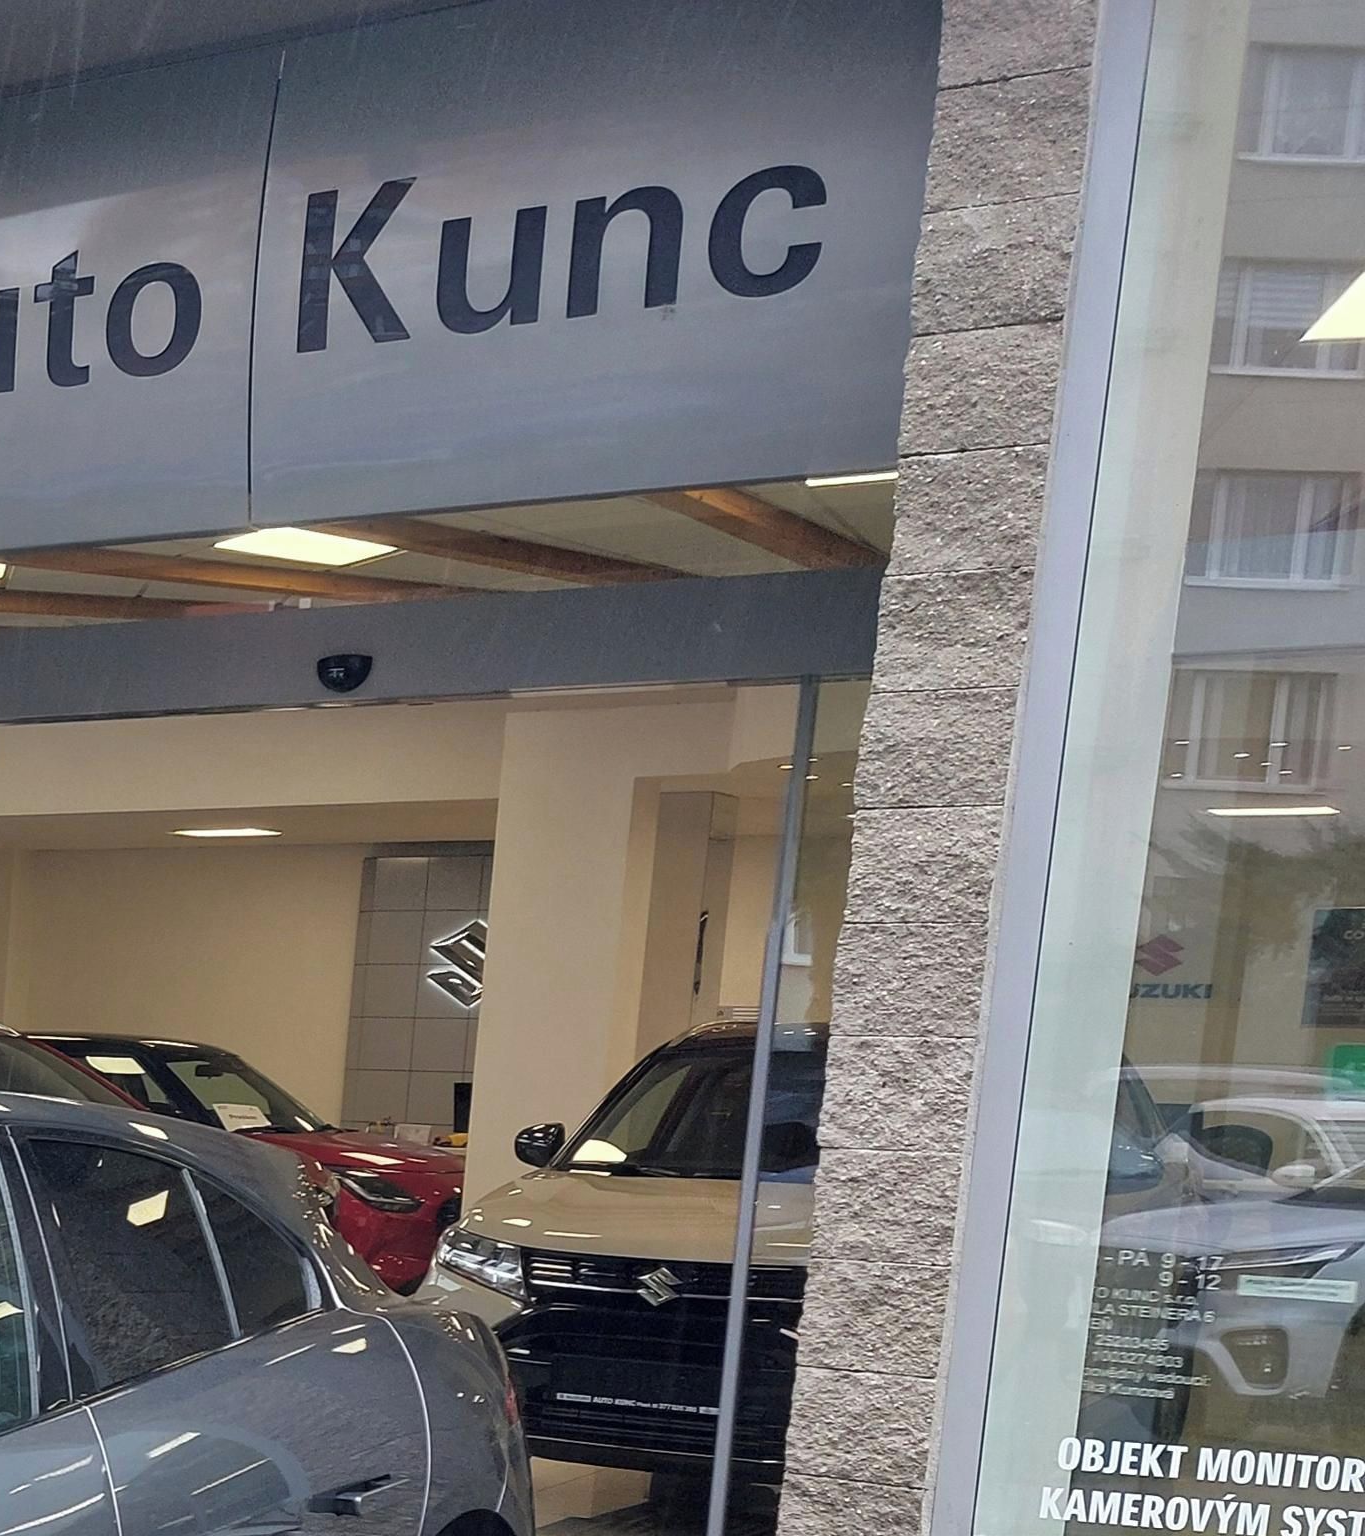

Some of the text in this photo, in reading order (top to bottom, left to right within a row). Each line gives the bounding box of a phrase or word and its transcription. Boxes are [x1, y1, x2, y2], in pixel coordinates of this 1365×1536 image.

[294, 163, 829, 356] Kunc
[1117, 1247, 1151, 1267] PÁ
[1160, 1252, 1177, 1269] 9
[1196, 1255, 1225, 1271] 17
[1158, 1270, 1175, 1288] 9
[1195, 1273, 1222, 1291] 12
[1057, 1437, 1365, 1493] OBJEKT MONITOR
